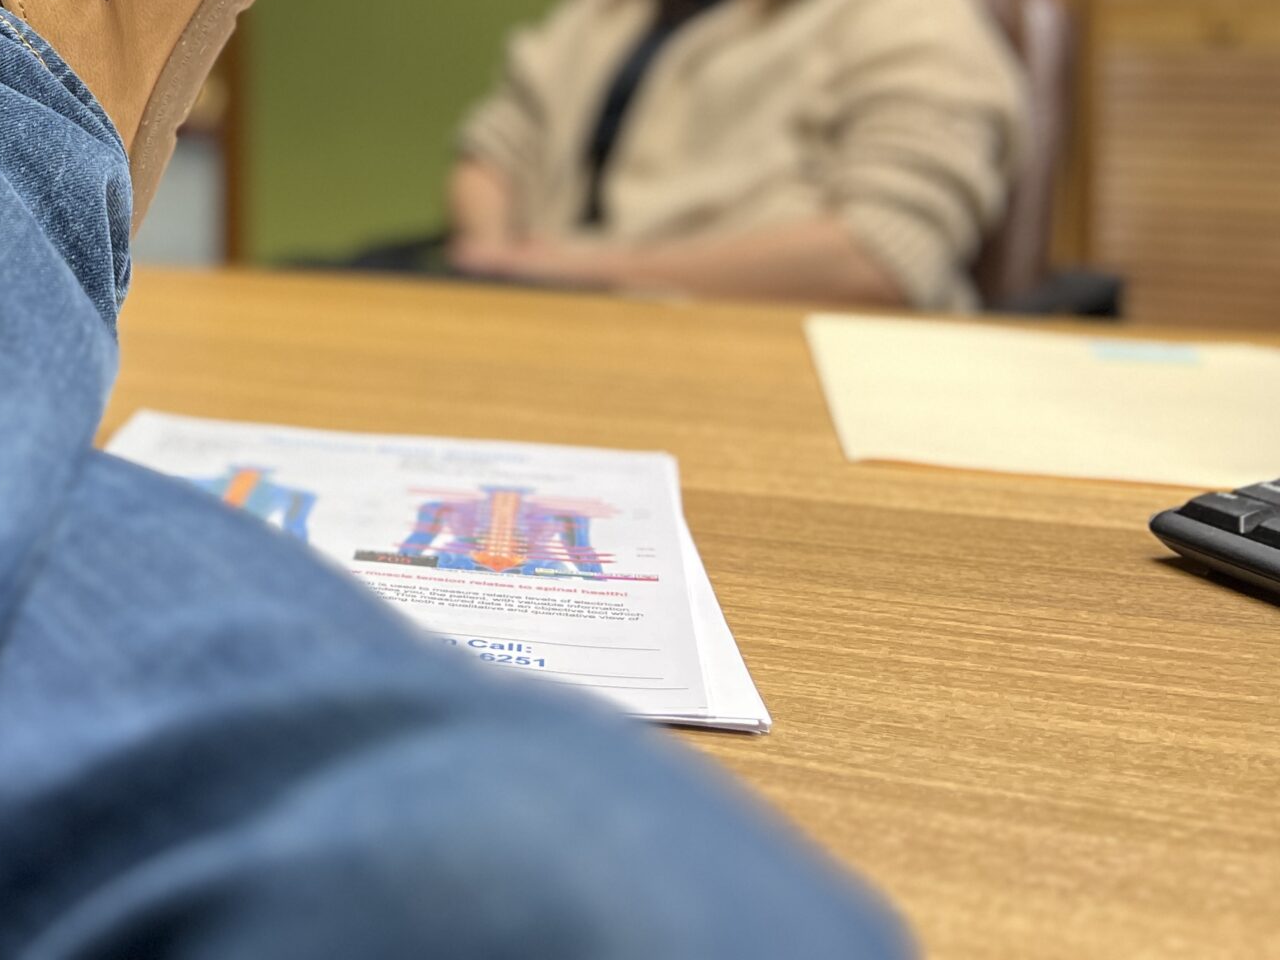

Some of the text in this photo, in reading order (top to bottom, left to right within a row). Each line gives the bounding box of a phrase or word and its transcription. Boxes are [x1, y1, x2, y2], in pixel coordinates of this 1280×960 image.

[365, 571, 413, 579] muscle
[417, 575, 465, 583] tension
[470, 580, 514, 588] relates
[448, 602, 504, 610] qualitative
[531, 610, 596, 618] quantitative
[567, 603, 630, 611] information
[467, 639, 532, 653] Call:
